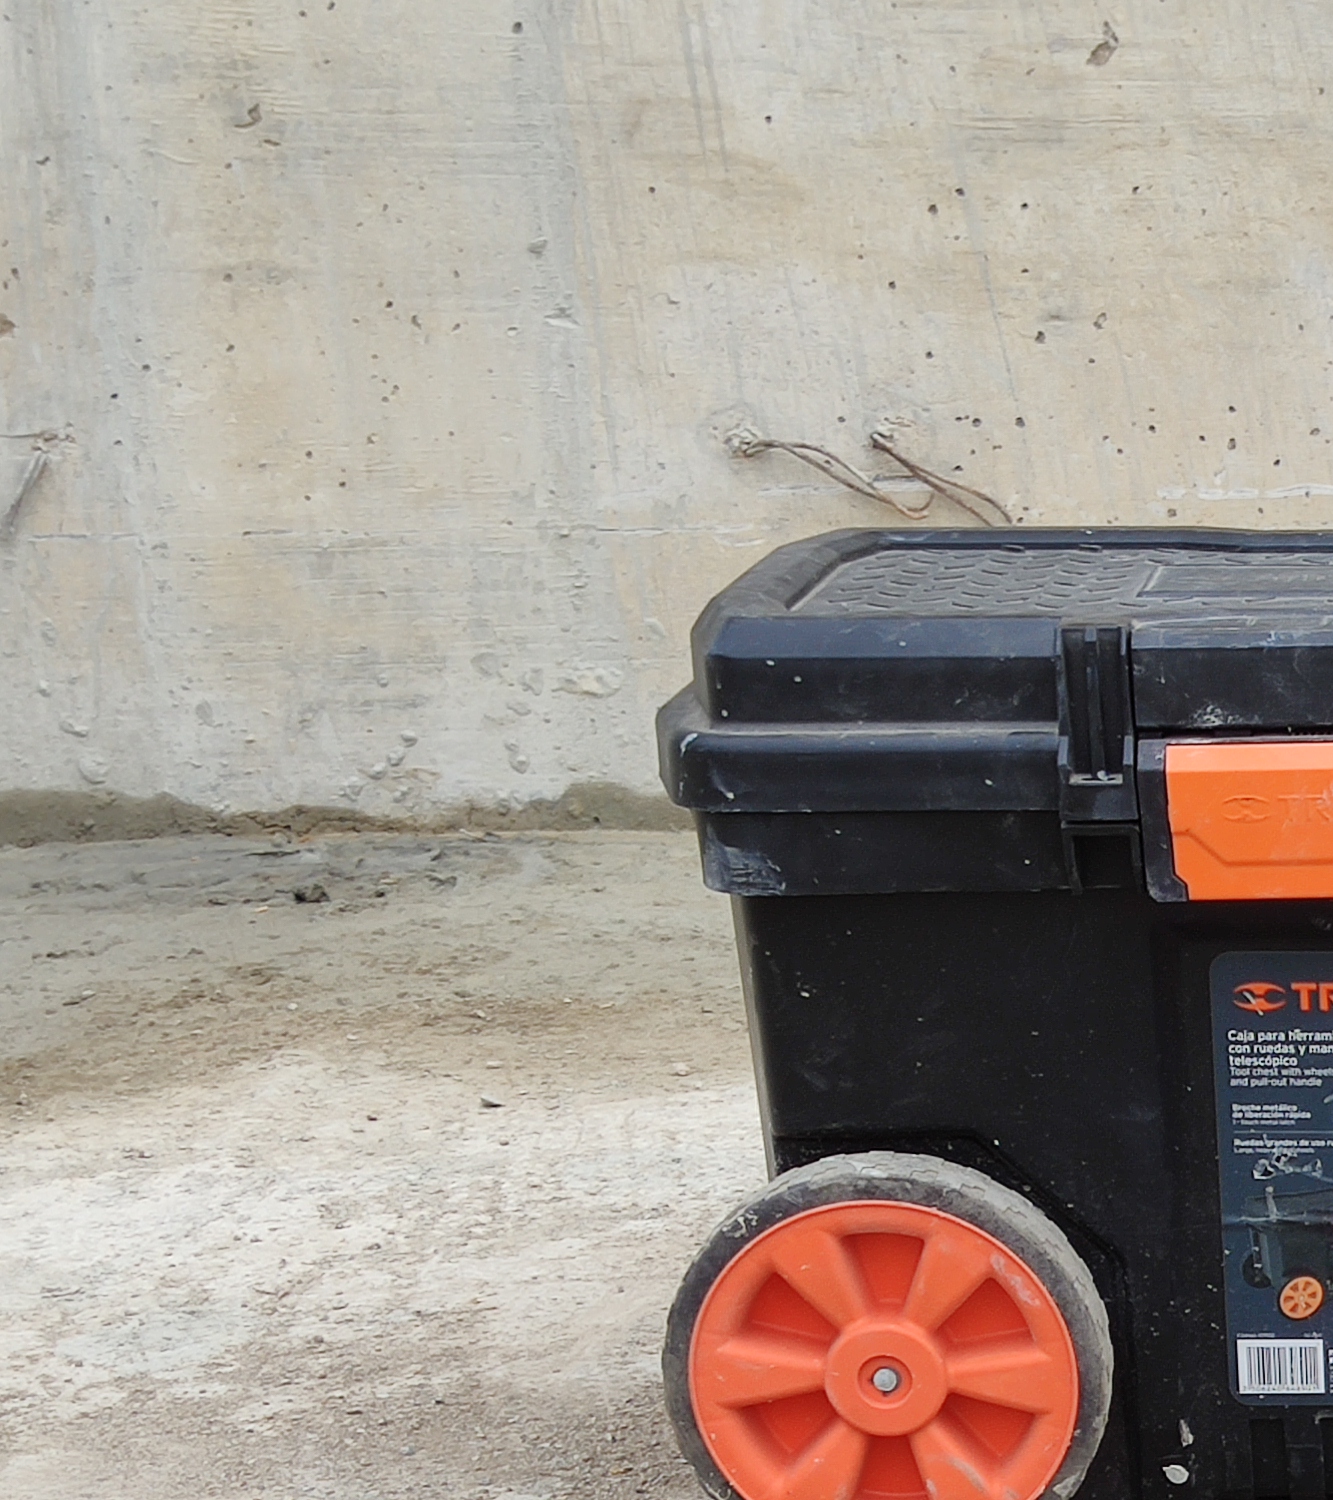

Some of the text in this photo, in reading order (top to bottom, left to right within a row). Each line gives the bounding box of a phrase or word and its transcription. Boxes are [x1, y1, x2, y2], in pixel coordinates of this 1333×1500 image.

[1227, 1029, 1255, 1043] Caja
[1257, 1031, 1285, 1043] para
[1228, 1044, 1251, 1054] con
[1253, 1043, 1295, 1054] ruedas
[1297, 1045, 1307, 1056] y
[1228, 1054, 1299, 1067] telescópico
[1229, 1067, 1250, 1077] Tool
[1251, 1067, 1279, 1077] chest
[1281, 1067, 1302, 1077] with
[1229, 1077, 1249, 1087] and
[1289, 1077, 1323, 1087] handle
